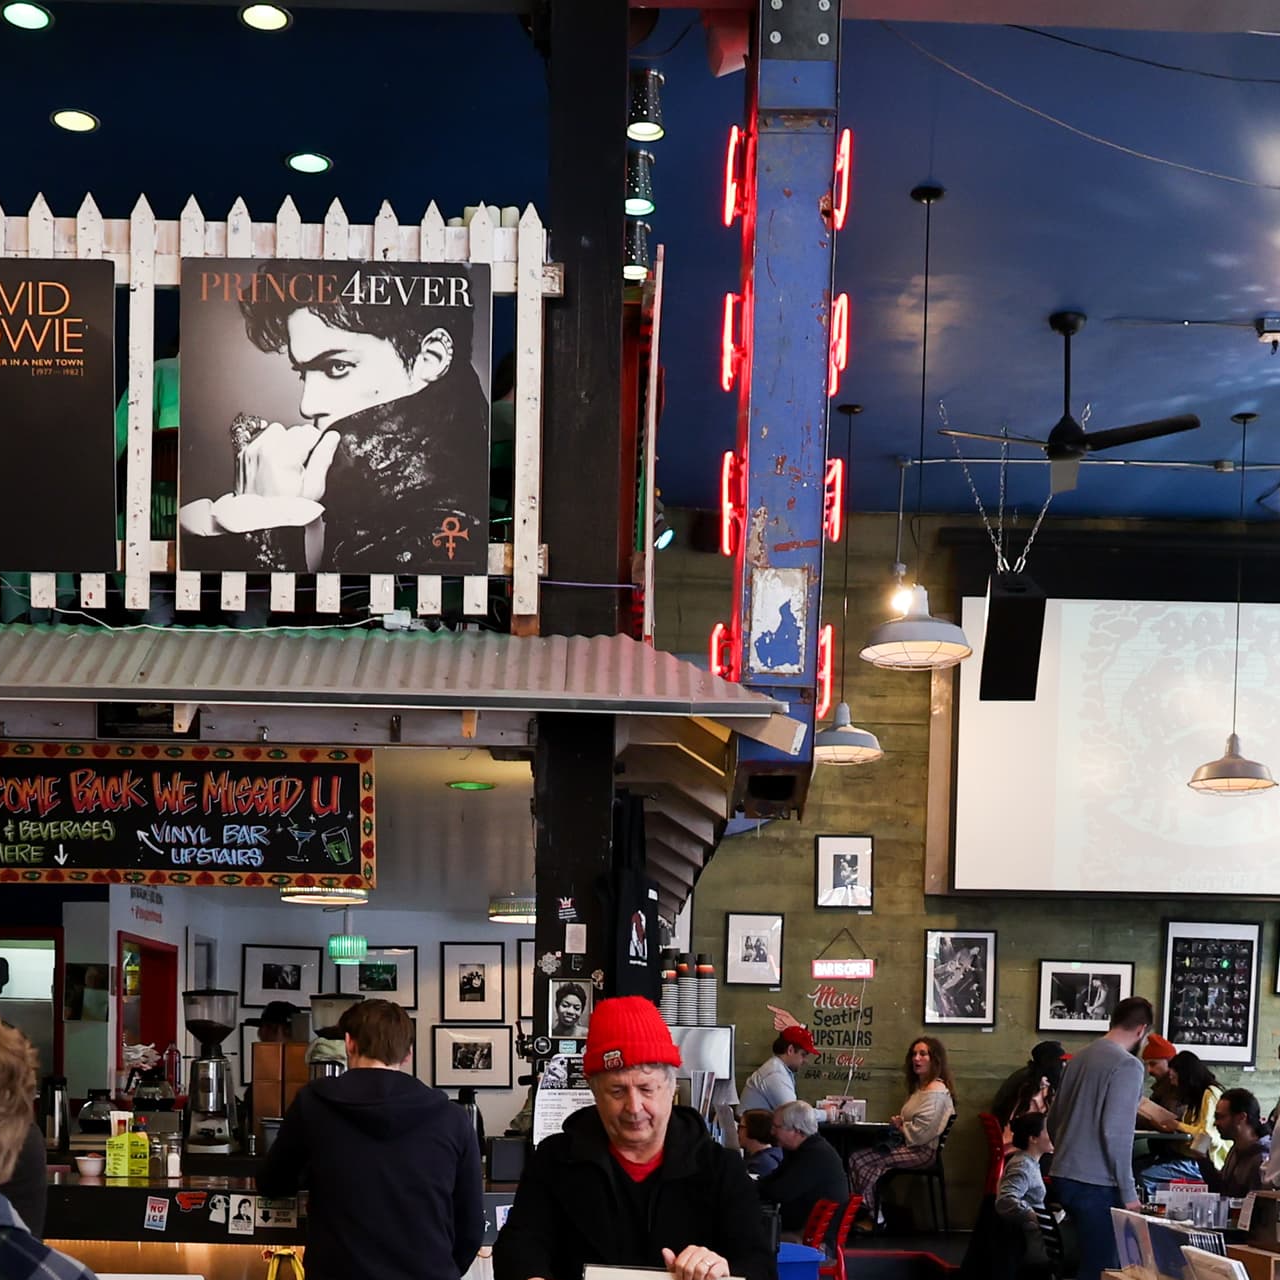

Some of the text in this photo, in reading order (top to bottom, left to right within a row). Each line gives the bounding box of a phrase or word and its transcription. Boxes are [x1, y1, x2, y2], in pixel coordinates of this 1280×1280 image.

[10, 358, 20, 366] IN
[22, 358, 29, 366] A
[32, 358, 53, 366] NEW
[56, 358, 84, 366] TOWN
[69, 768, 148, 814] BACK
[153, 771, 199, 815] WE
[203, 770, 304, 816] MISSED
[311, 776, 341, 815] U
[19, 820, 116, 840] BEVERAGES
[152, 823, 212, 845] VINYL
[223, 825, 270, 846] BAR
[171, 847, 264, 866] UPSTAIRS
[807, 984, 858, 1009] More
[813, 1007, 873, 1026] Seating
[813, 1030, 872, 1046] UPSTAIRS
